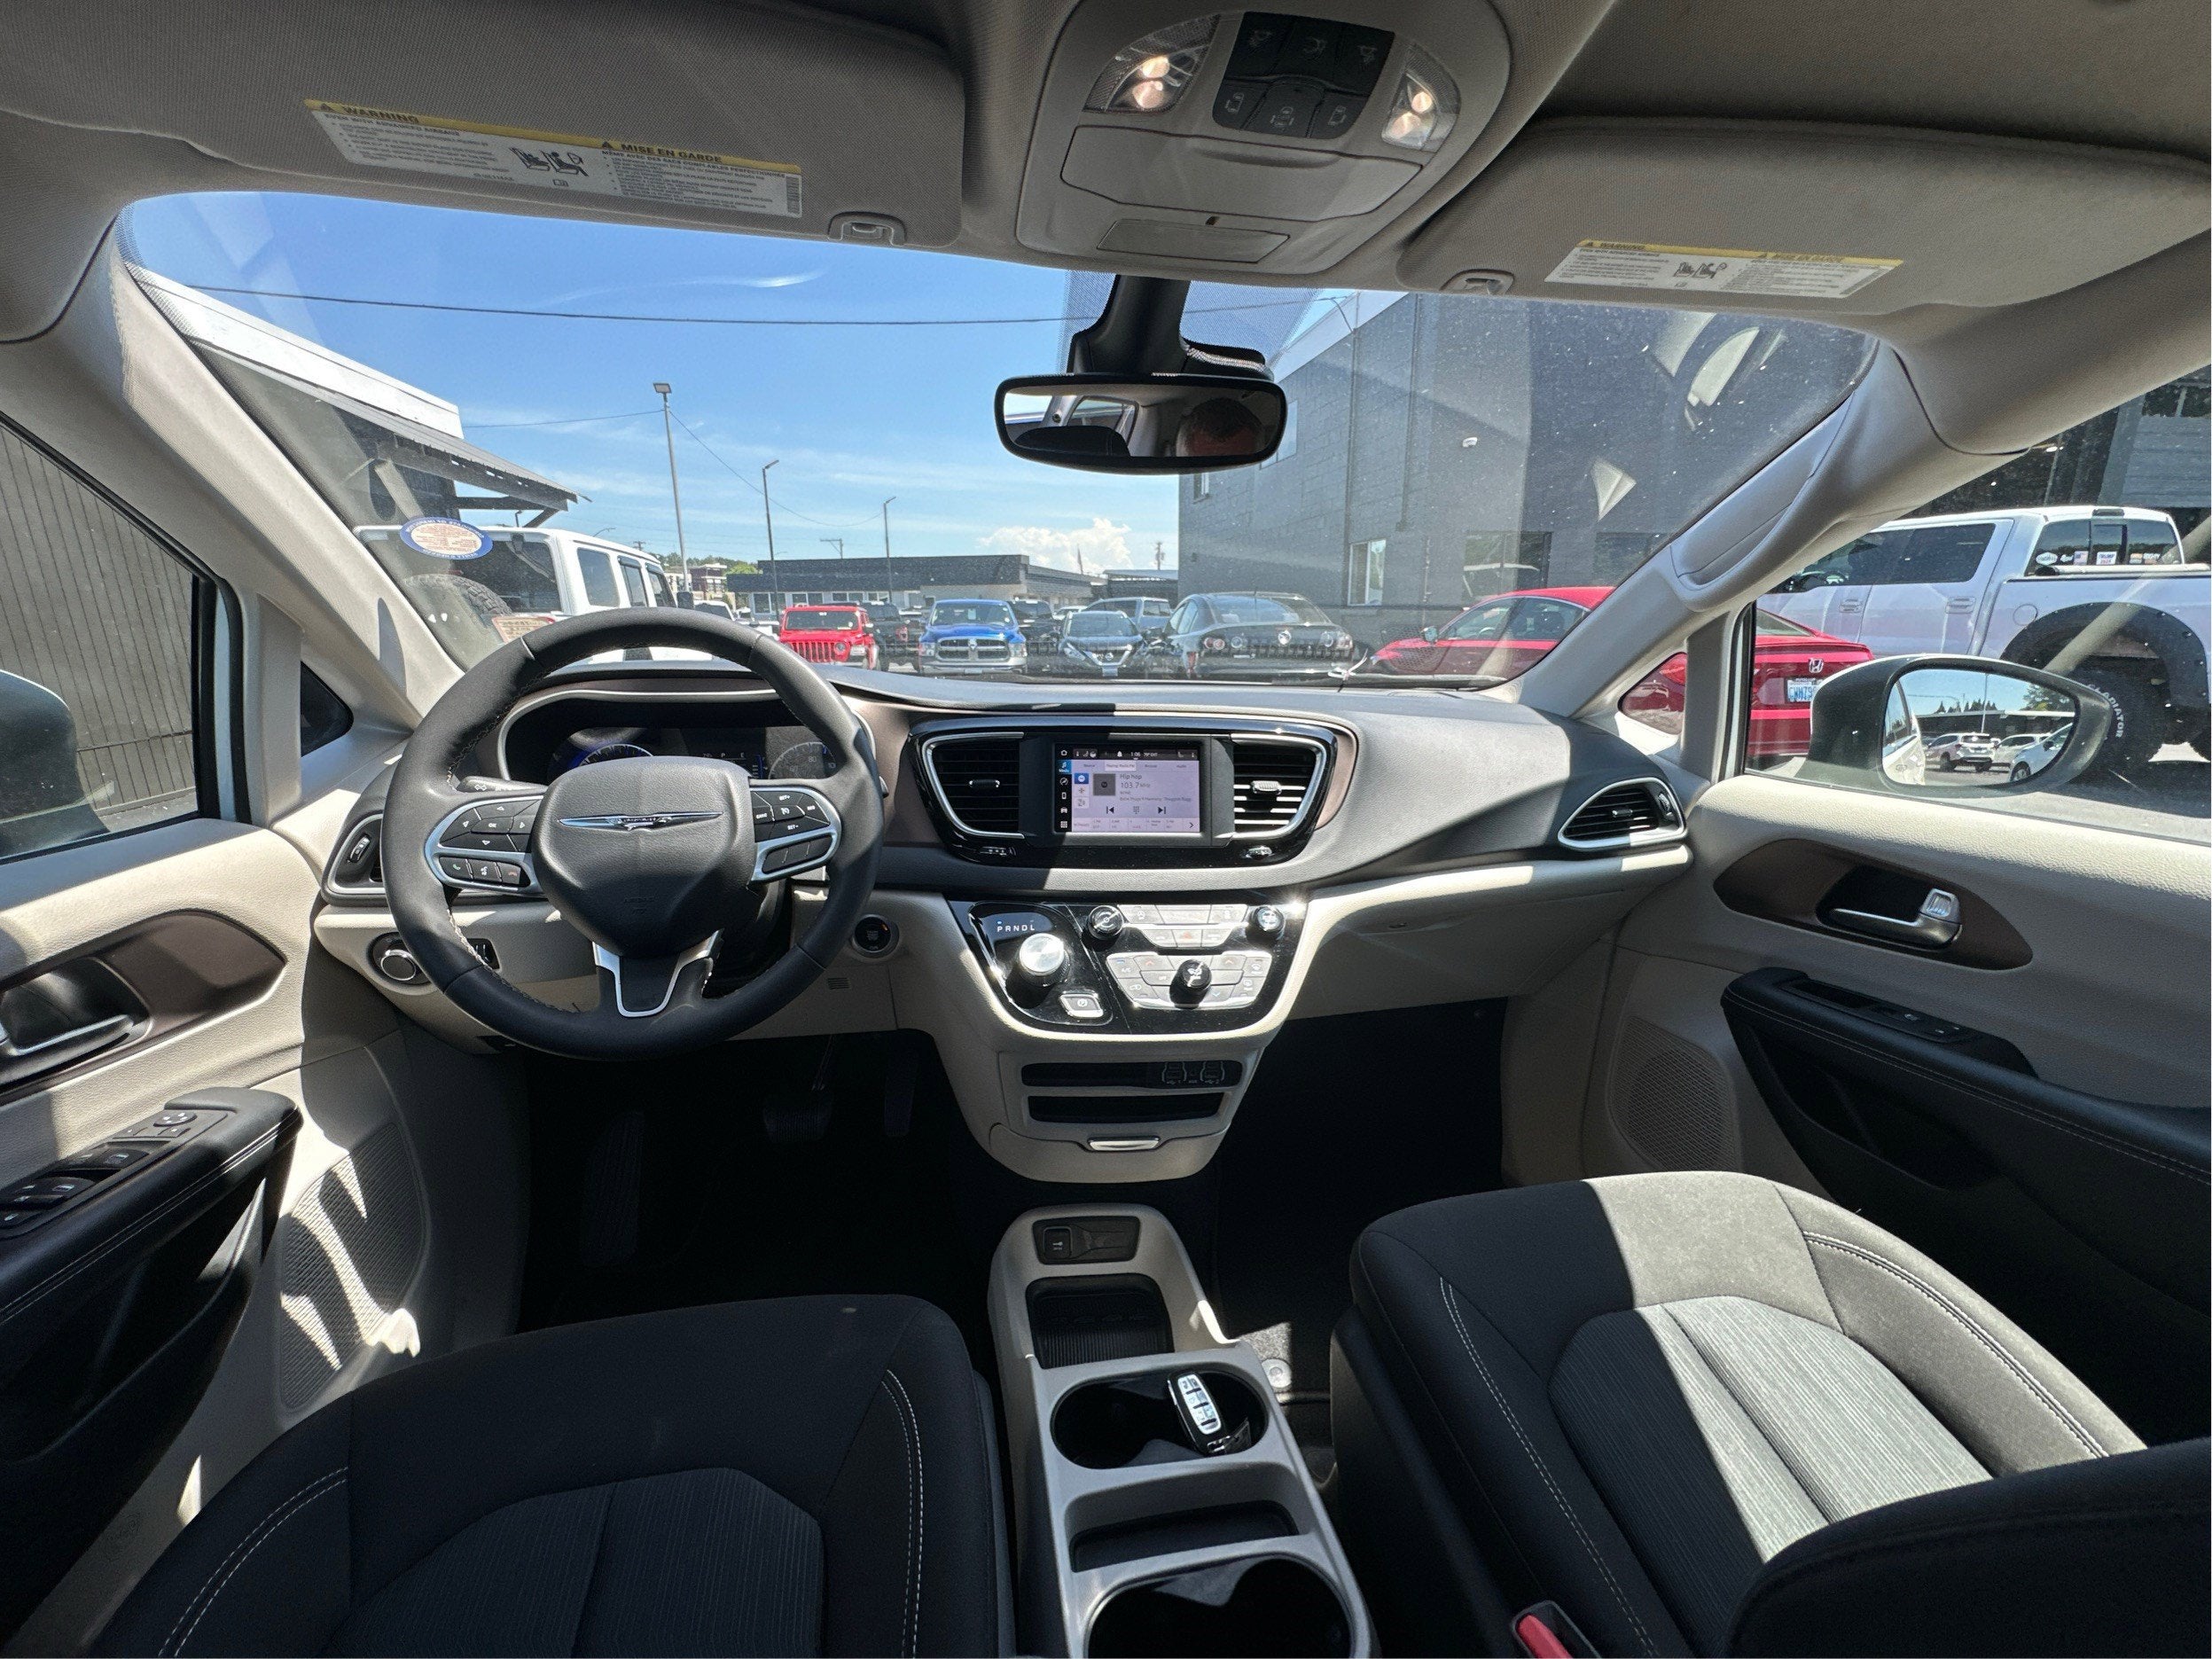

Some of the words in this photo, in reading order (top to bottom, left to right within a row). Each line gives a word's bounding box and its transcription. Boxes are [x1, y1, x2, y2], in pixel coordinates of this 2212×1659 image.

[343, 106, 419, 123] WARNING
[621, 143, 654, 154] MISE
[657, 147, 676, 157] EN
[678, 151, 723, 163] GARDE
